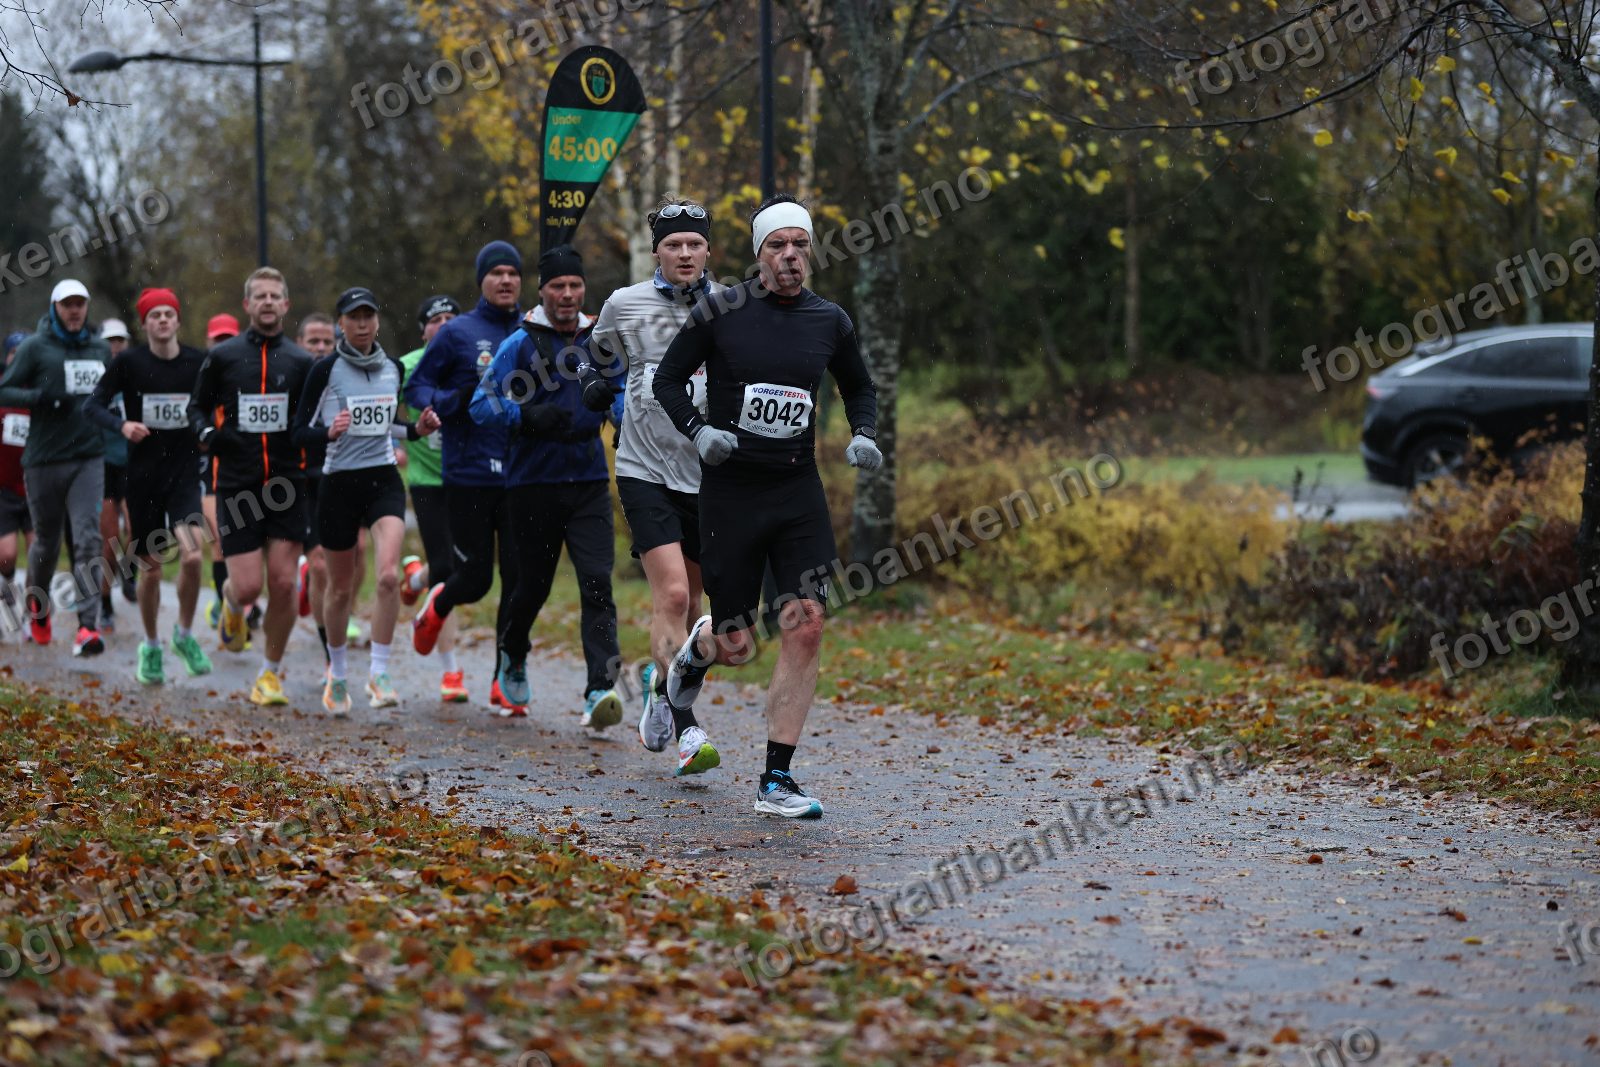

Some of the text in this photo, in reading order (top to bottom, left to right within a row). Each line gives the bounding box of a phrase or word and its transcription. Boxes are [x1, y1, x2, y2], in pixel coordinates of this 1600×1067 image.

[552, 115, 581, 125] Under
[549, 135, 617, 162] 45:00
[549, 190, 586, 208] 4:30
[74, 370, 99, 386] 562
[752, 387, 807, 400] NORGESTESTEN
[154, 404, 182, 421] 165
[249, 405, 279, 423] 385
[353, 405, 391, 425] 9361
[748, 397, 805, 427] 3042
